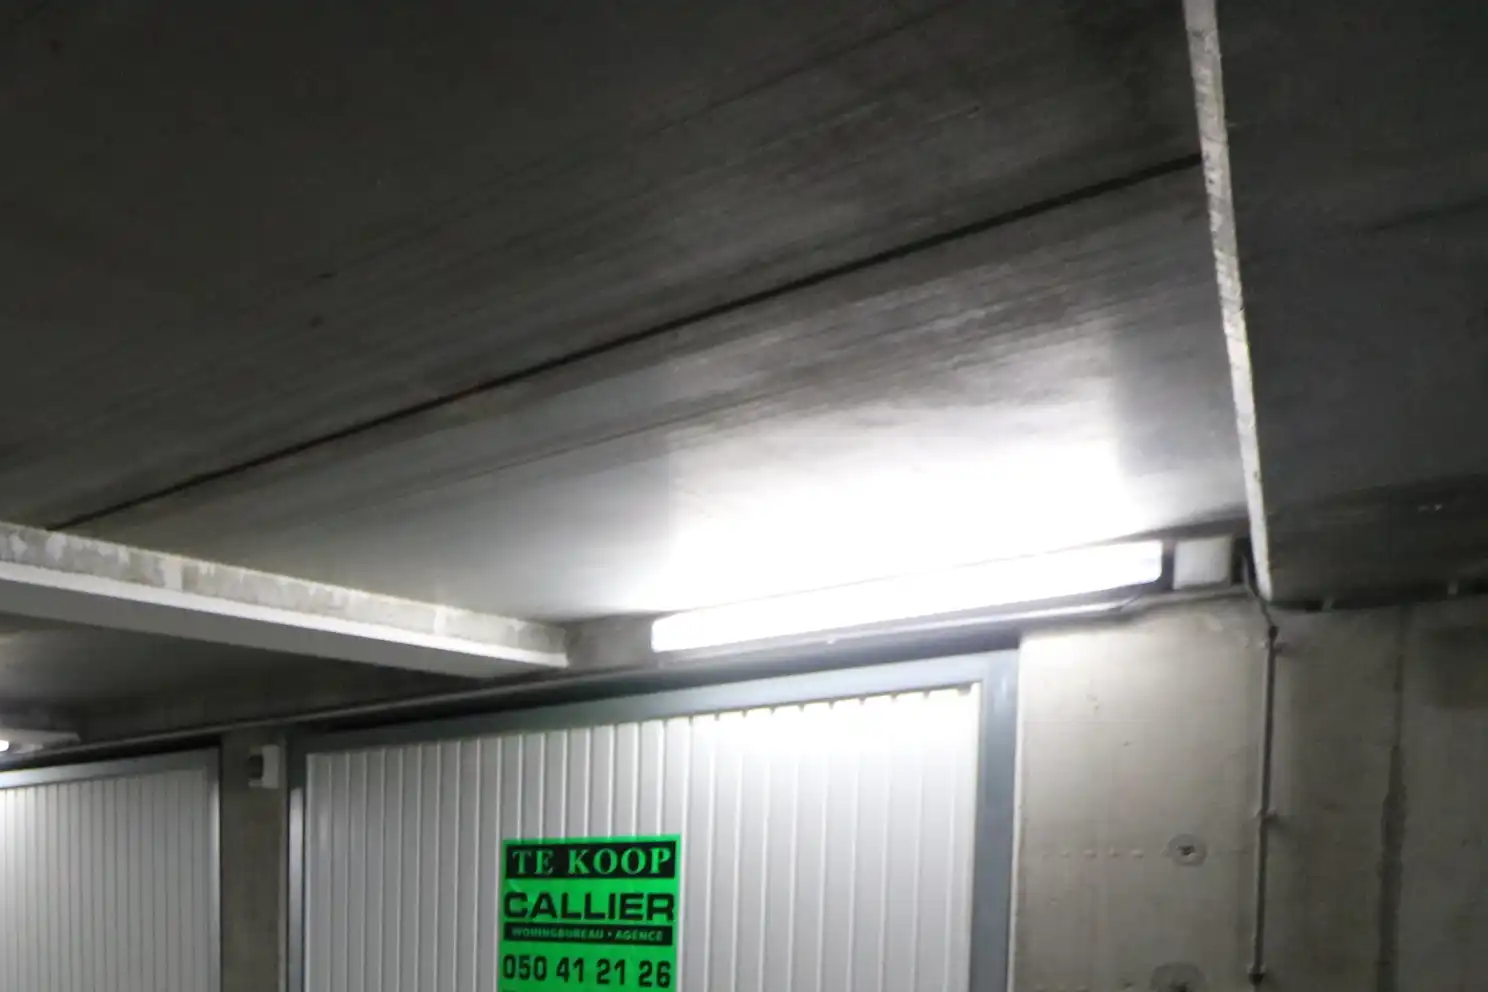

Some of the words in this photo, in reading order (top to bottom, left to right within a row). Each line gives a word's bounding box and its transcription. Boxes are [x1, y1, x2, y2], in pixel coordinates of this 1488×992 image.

[511, 848, 554, 875] TE
[568, 847, 672, 875] KOOP
[503, 891, 675, 922] CALLIER
[615, 929, 664, 942] AGENCE
[502, 953, 547, 981] 050
[556, 956, 585, 983] 41
[596, 958, 626, 986] 21
[638, 960, 672, 989] 26
